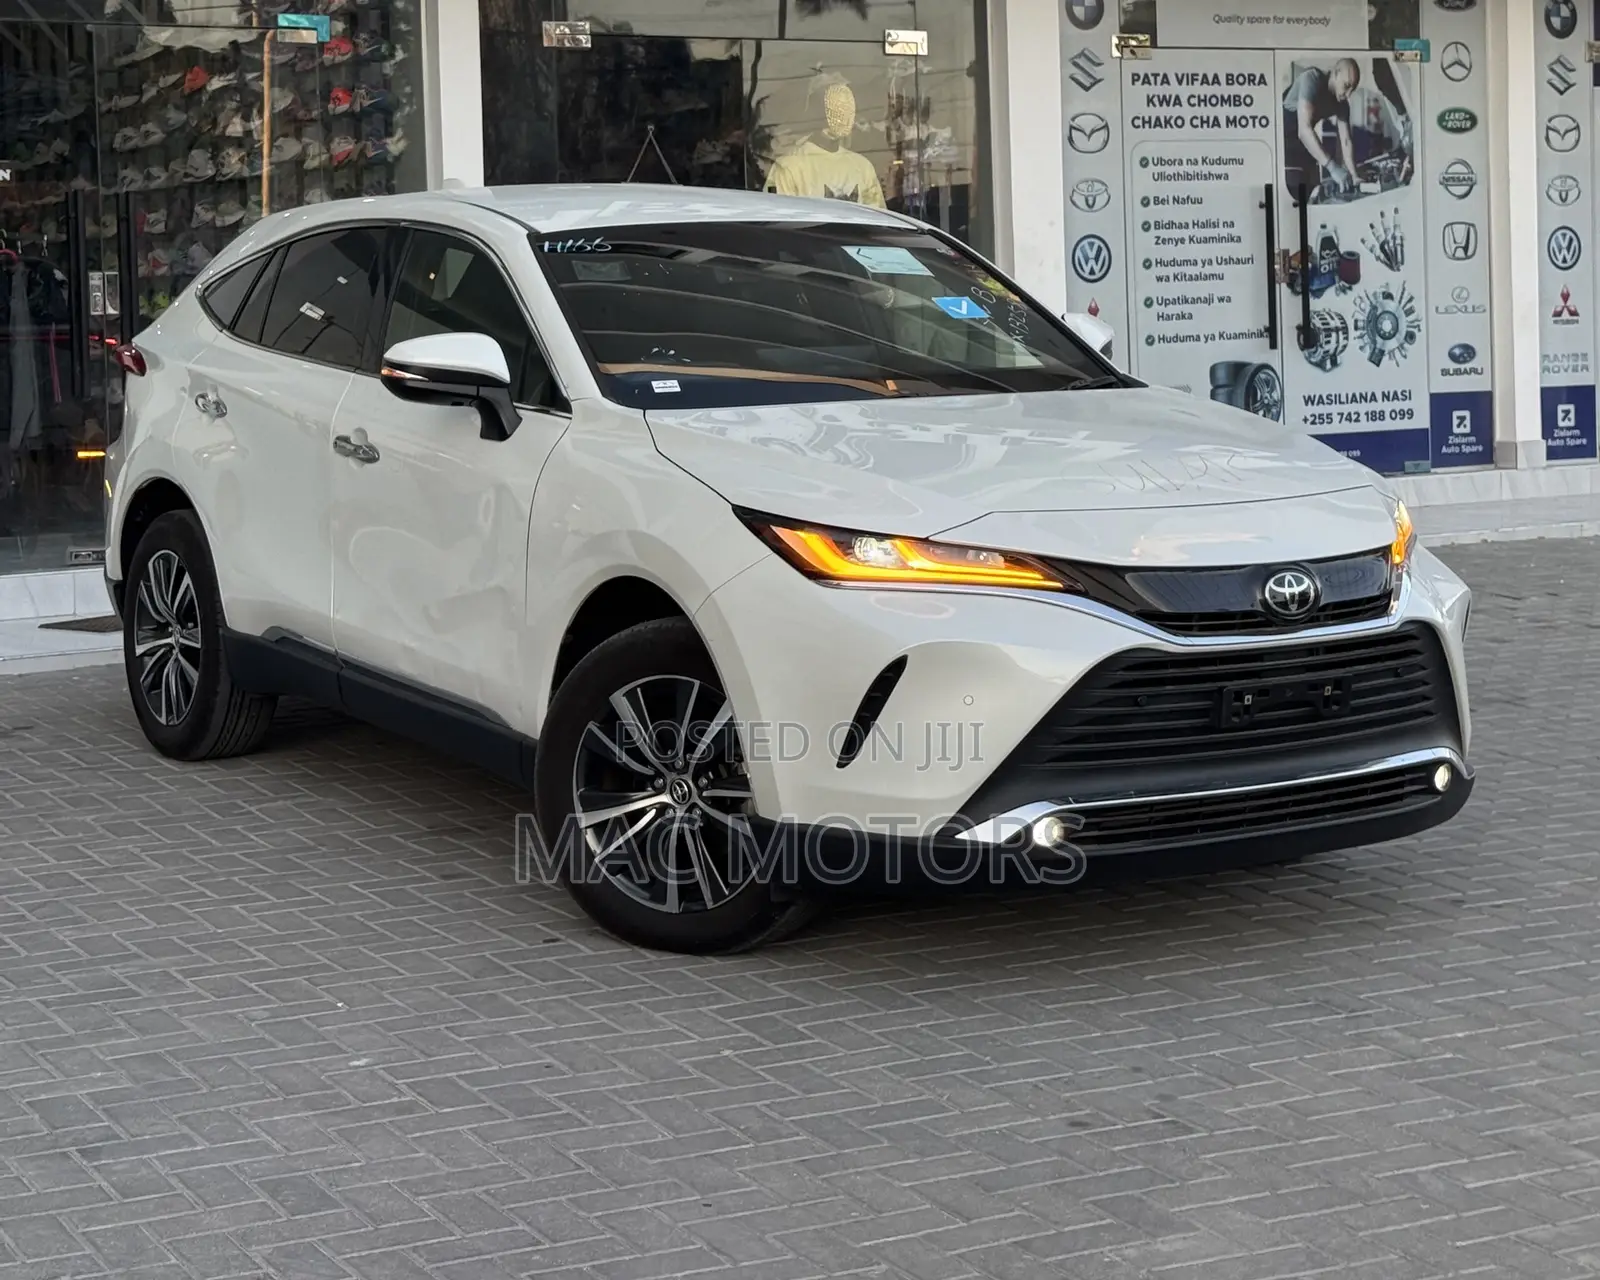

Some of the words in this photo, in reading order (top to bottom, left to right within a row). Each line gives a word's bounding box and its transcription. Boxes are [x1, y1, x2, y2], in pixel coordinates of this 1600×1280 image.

[1212, 14, 1245, 25] Quality
[1246, 15, 1271, 25] spare
[1273, 14, 1284, 24] for
[1286, 15, 1331, 27] everybody
[1131, 72, 1171, 86] PATA
[1174, 72, 1222, 86] VIFAA
[1225, 73, 1268, 86] BORA
[1146, 94, 1183, 107] KWA
[1187, 94, 1254, 107] CHOMBO
[1131, 115, 1185, 129] CHAKO
[1189, 115, 1222, 129] CHA
[1225, 115, 1270, 129] MOTO
[1152, 156, 1184, 167] Ubora
[1186, 157, 1199, 166] na
[1201, 156, 1244, 166] Kudumu
[1152, 170, 1229, 182] Uliothibitishwa
[1153, 194, 1169, 206] Bei
[1172, 194, 1203, 205] Nafuu
[1153, 220, 1189, 231] Bidhaa
[1192, 218, 1220, 229] Halisi
[1222, 220, 1235, 229] na
[1154, 235, 1186, 247] Zenye
[1188, 232, 1242, 245] Kuaminika
[1155, 257, 1199, 268] Huduma
[1201, 258, 1213, 268] ya
[1216, 254, 1255, 266] Ushauri
[1156, 274, 1170, 283] wa
[1173, 271, 1225, 283] Kitaalamu
[1156, 293, 1215, 308] Upatikanaji
[1217, 295, 1232, 304] wa
[1435, 304, 1487, 314] LEXUS
[1157, 311, 1194, 322] Haraka
[1158, 332, 1201, 344] Huduma
[1203, 333, 1216, 343] ya
[1440, 367, 1484, 377] SUBARU
[1302, 391, 1378, 407] WASILIANA
[1381, 389, 1413, 402] NASI
[1302, 412, 1334, 425] +255
[1337, 411, 1361, 424] 742
[1364, 409, 1386, 422] 188
[1389, 408, 1415, 421] 099
[1441, 445, 1460, 454] Auto
[1461, 444, 1484, 454] Spare
